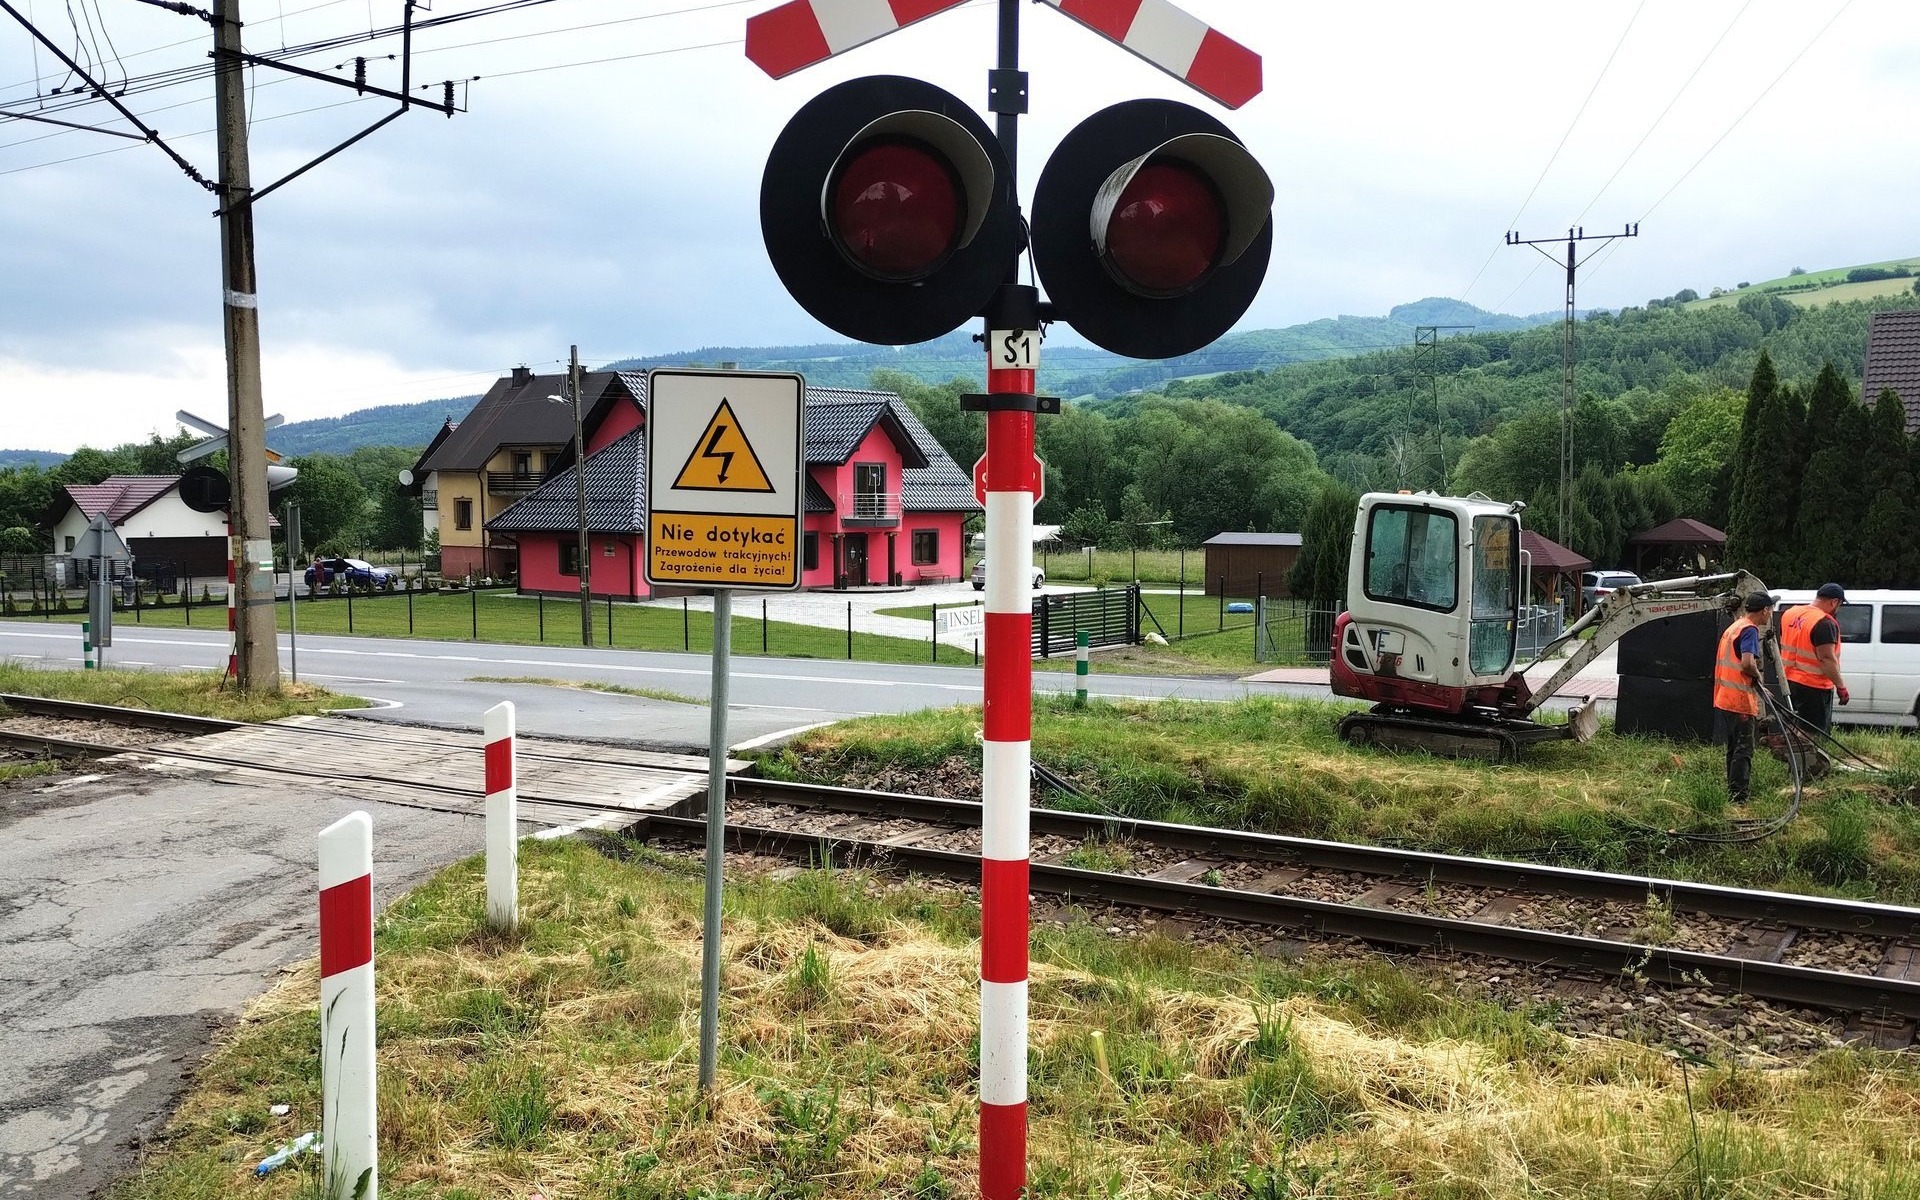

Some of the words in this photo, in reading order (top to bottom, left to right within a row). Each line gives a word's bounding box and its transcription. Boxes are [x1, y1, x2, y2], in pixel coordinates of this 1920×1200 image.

[1004, 336, 1030, 363] S1
[662, 523, 694, 540] Nie
[706, 526, 784, 547] dotykać
[655, 547, 717, 558] Przewodów
[723, 549, 791, 563] trakcyjnych!
[660, 561, 722, 574] Zagrożenie
[729, 564, 747, 574] dla
[753, 565, 785, 577] życia!
